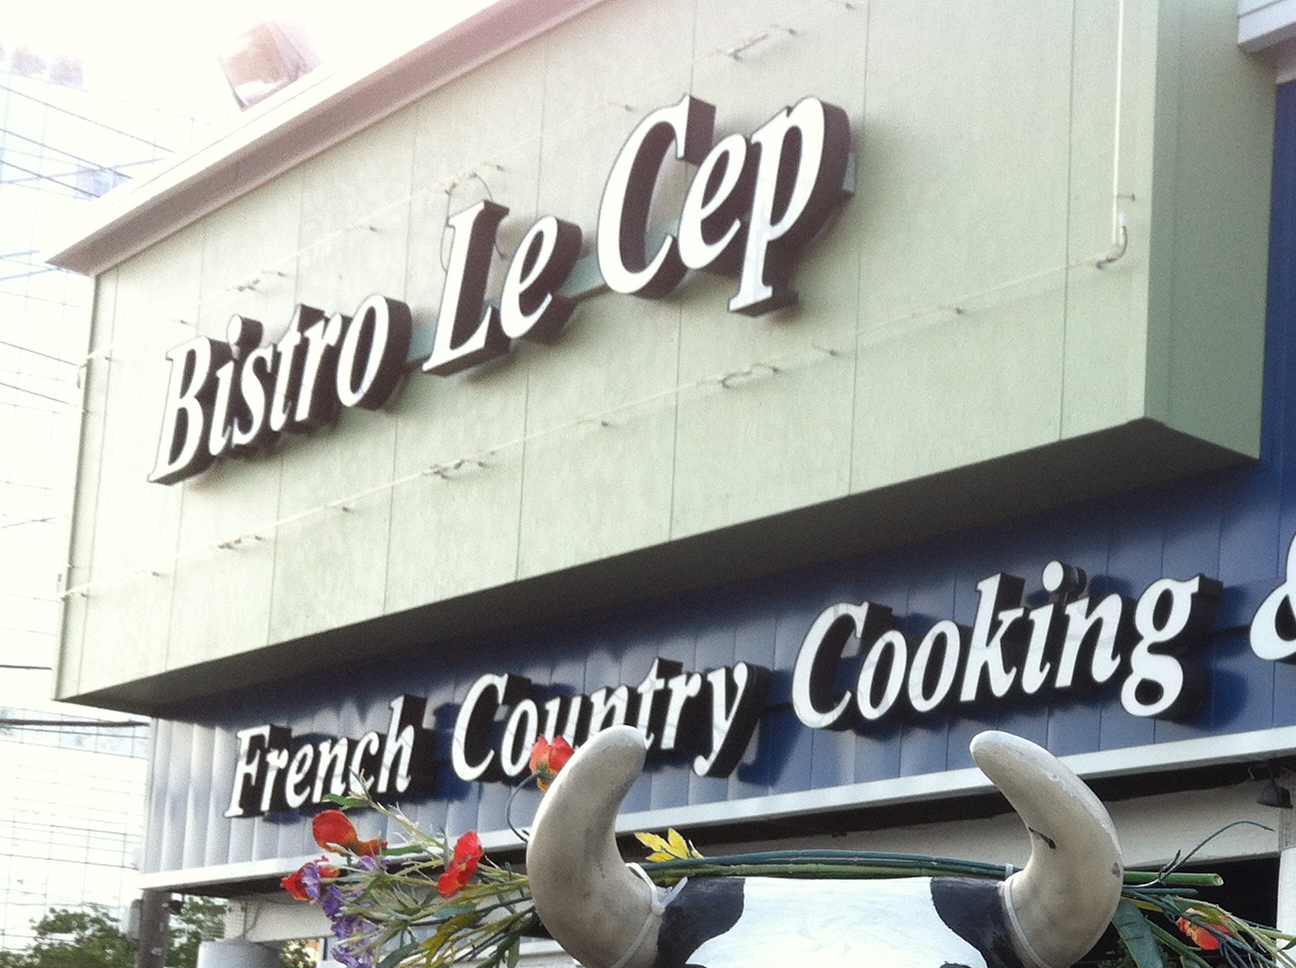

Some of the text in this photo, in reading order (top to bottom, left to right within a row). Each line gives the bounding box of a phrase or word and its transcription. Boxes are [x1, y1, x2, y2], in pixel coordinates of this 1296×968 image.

[147, 92, 829, 484] Bistro Le Cep
[224, 695, 414, 818] French
[451, 656, 748, 777] Country
[792, 560, 1200, 730] Cooking
